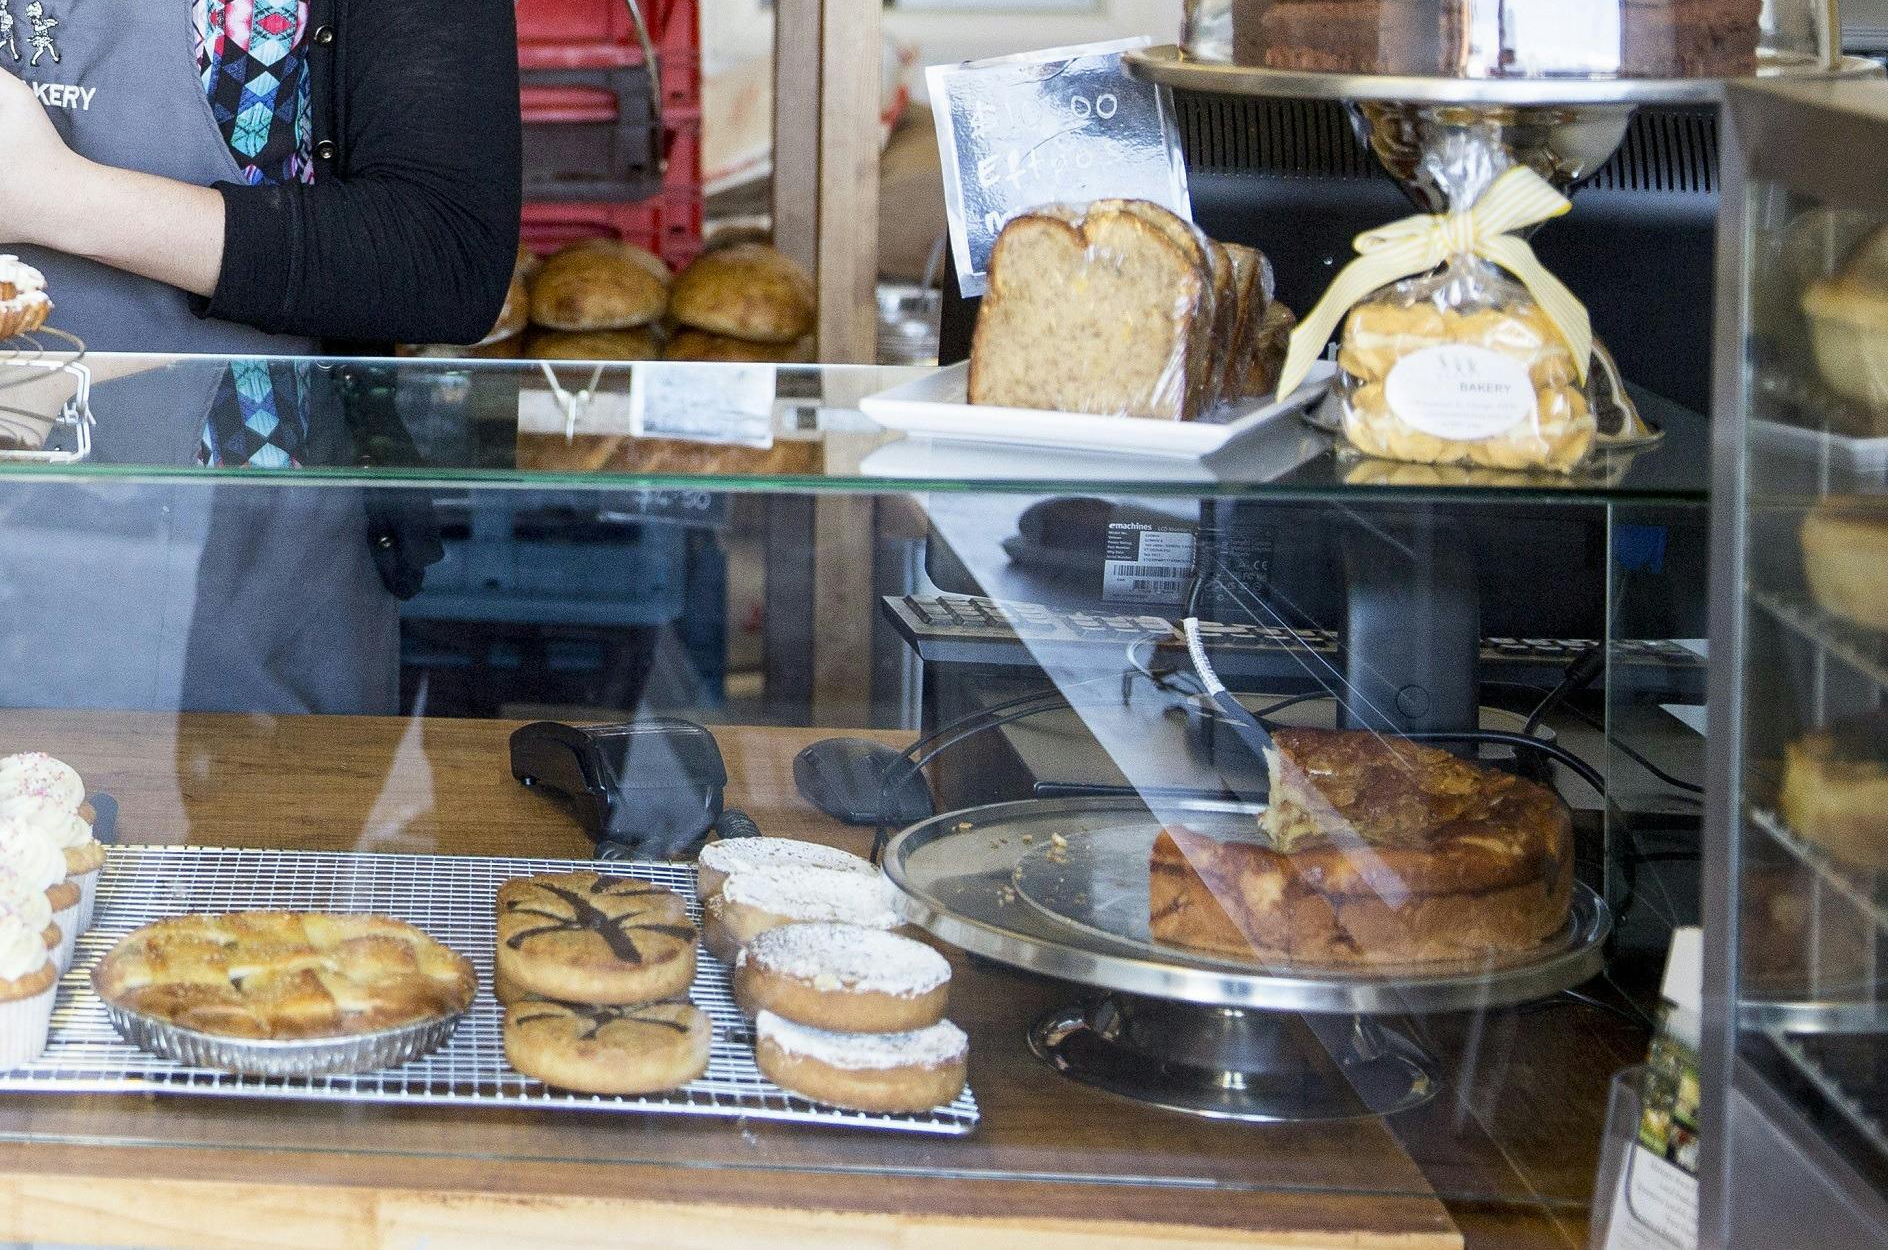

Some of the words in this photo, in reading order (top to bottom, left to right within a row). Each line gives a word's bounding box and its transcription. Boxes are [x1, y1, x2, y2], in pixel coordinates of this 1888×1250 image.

[21, 80, 97, 111] KERY
[1459, 382, 1511, 394] BAKERY
[1108, 522, 1152, 531] emachines
